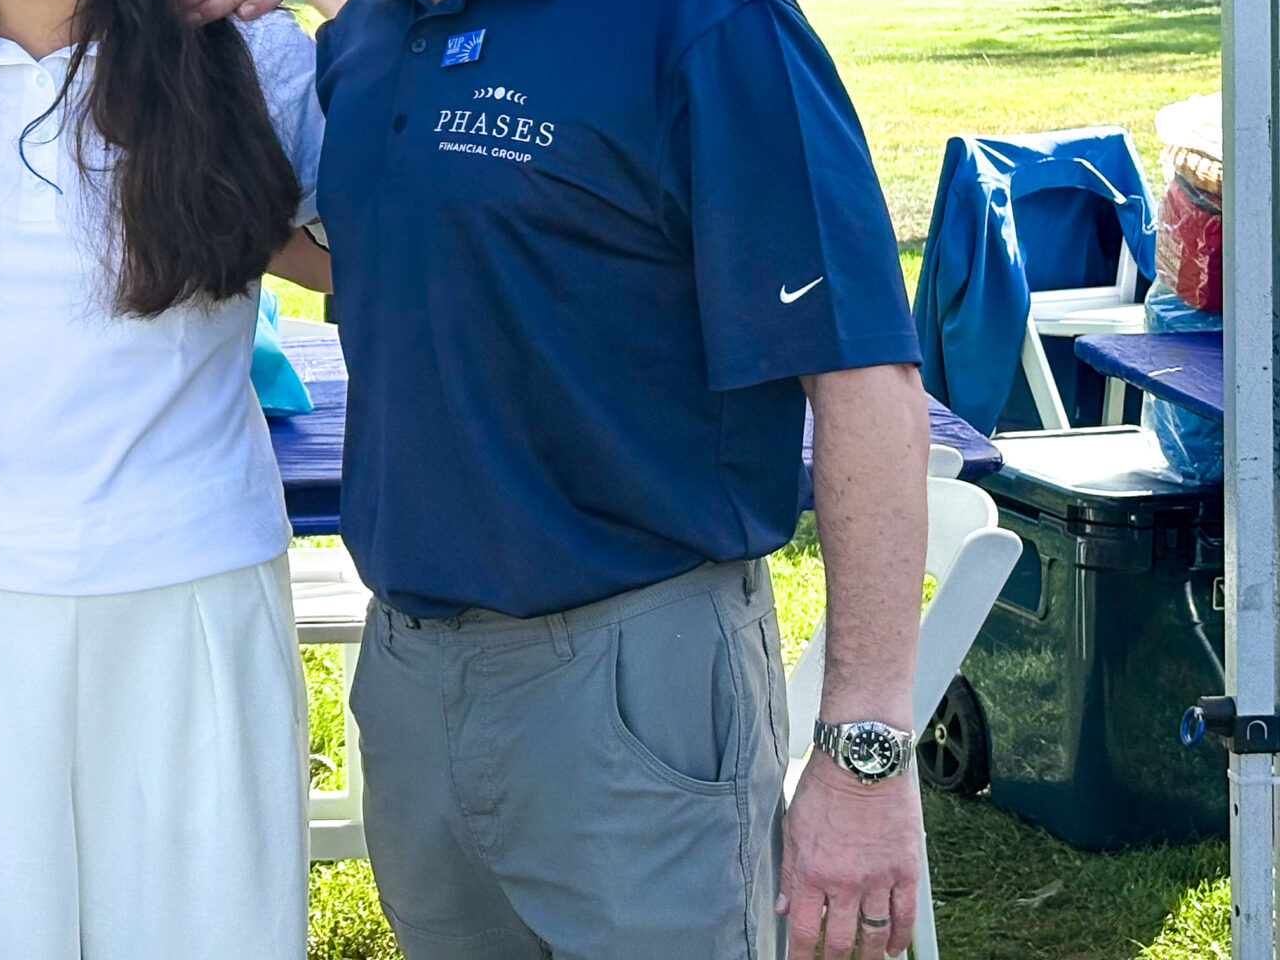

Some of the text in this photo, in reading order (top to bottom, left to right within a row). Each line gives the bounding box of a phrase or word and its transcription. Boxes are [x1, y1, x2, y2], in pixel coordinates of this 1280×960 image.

[433, 110, 555, 147] PHASES
[438, 141, 532, 163] FINANCIAL GROUP
